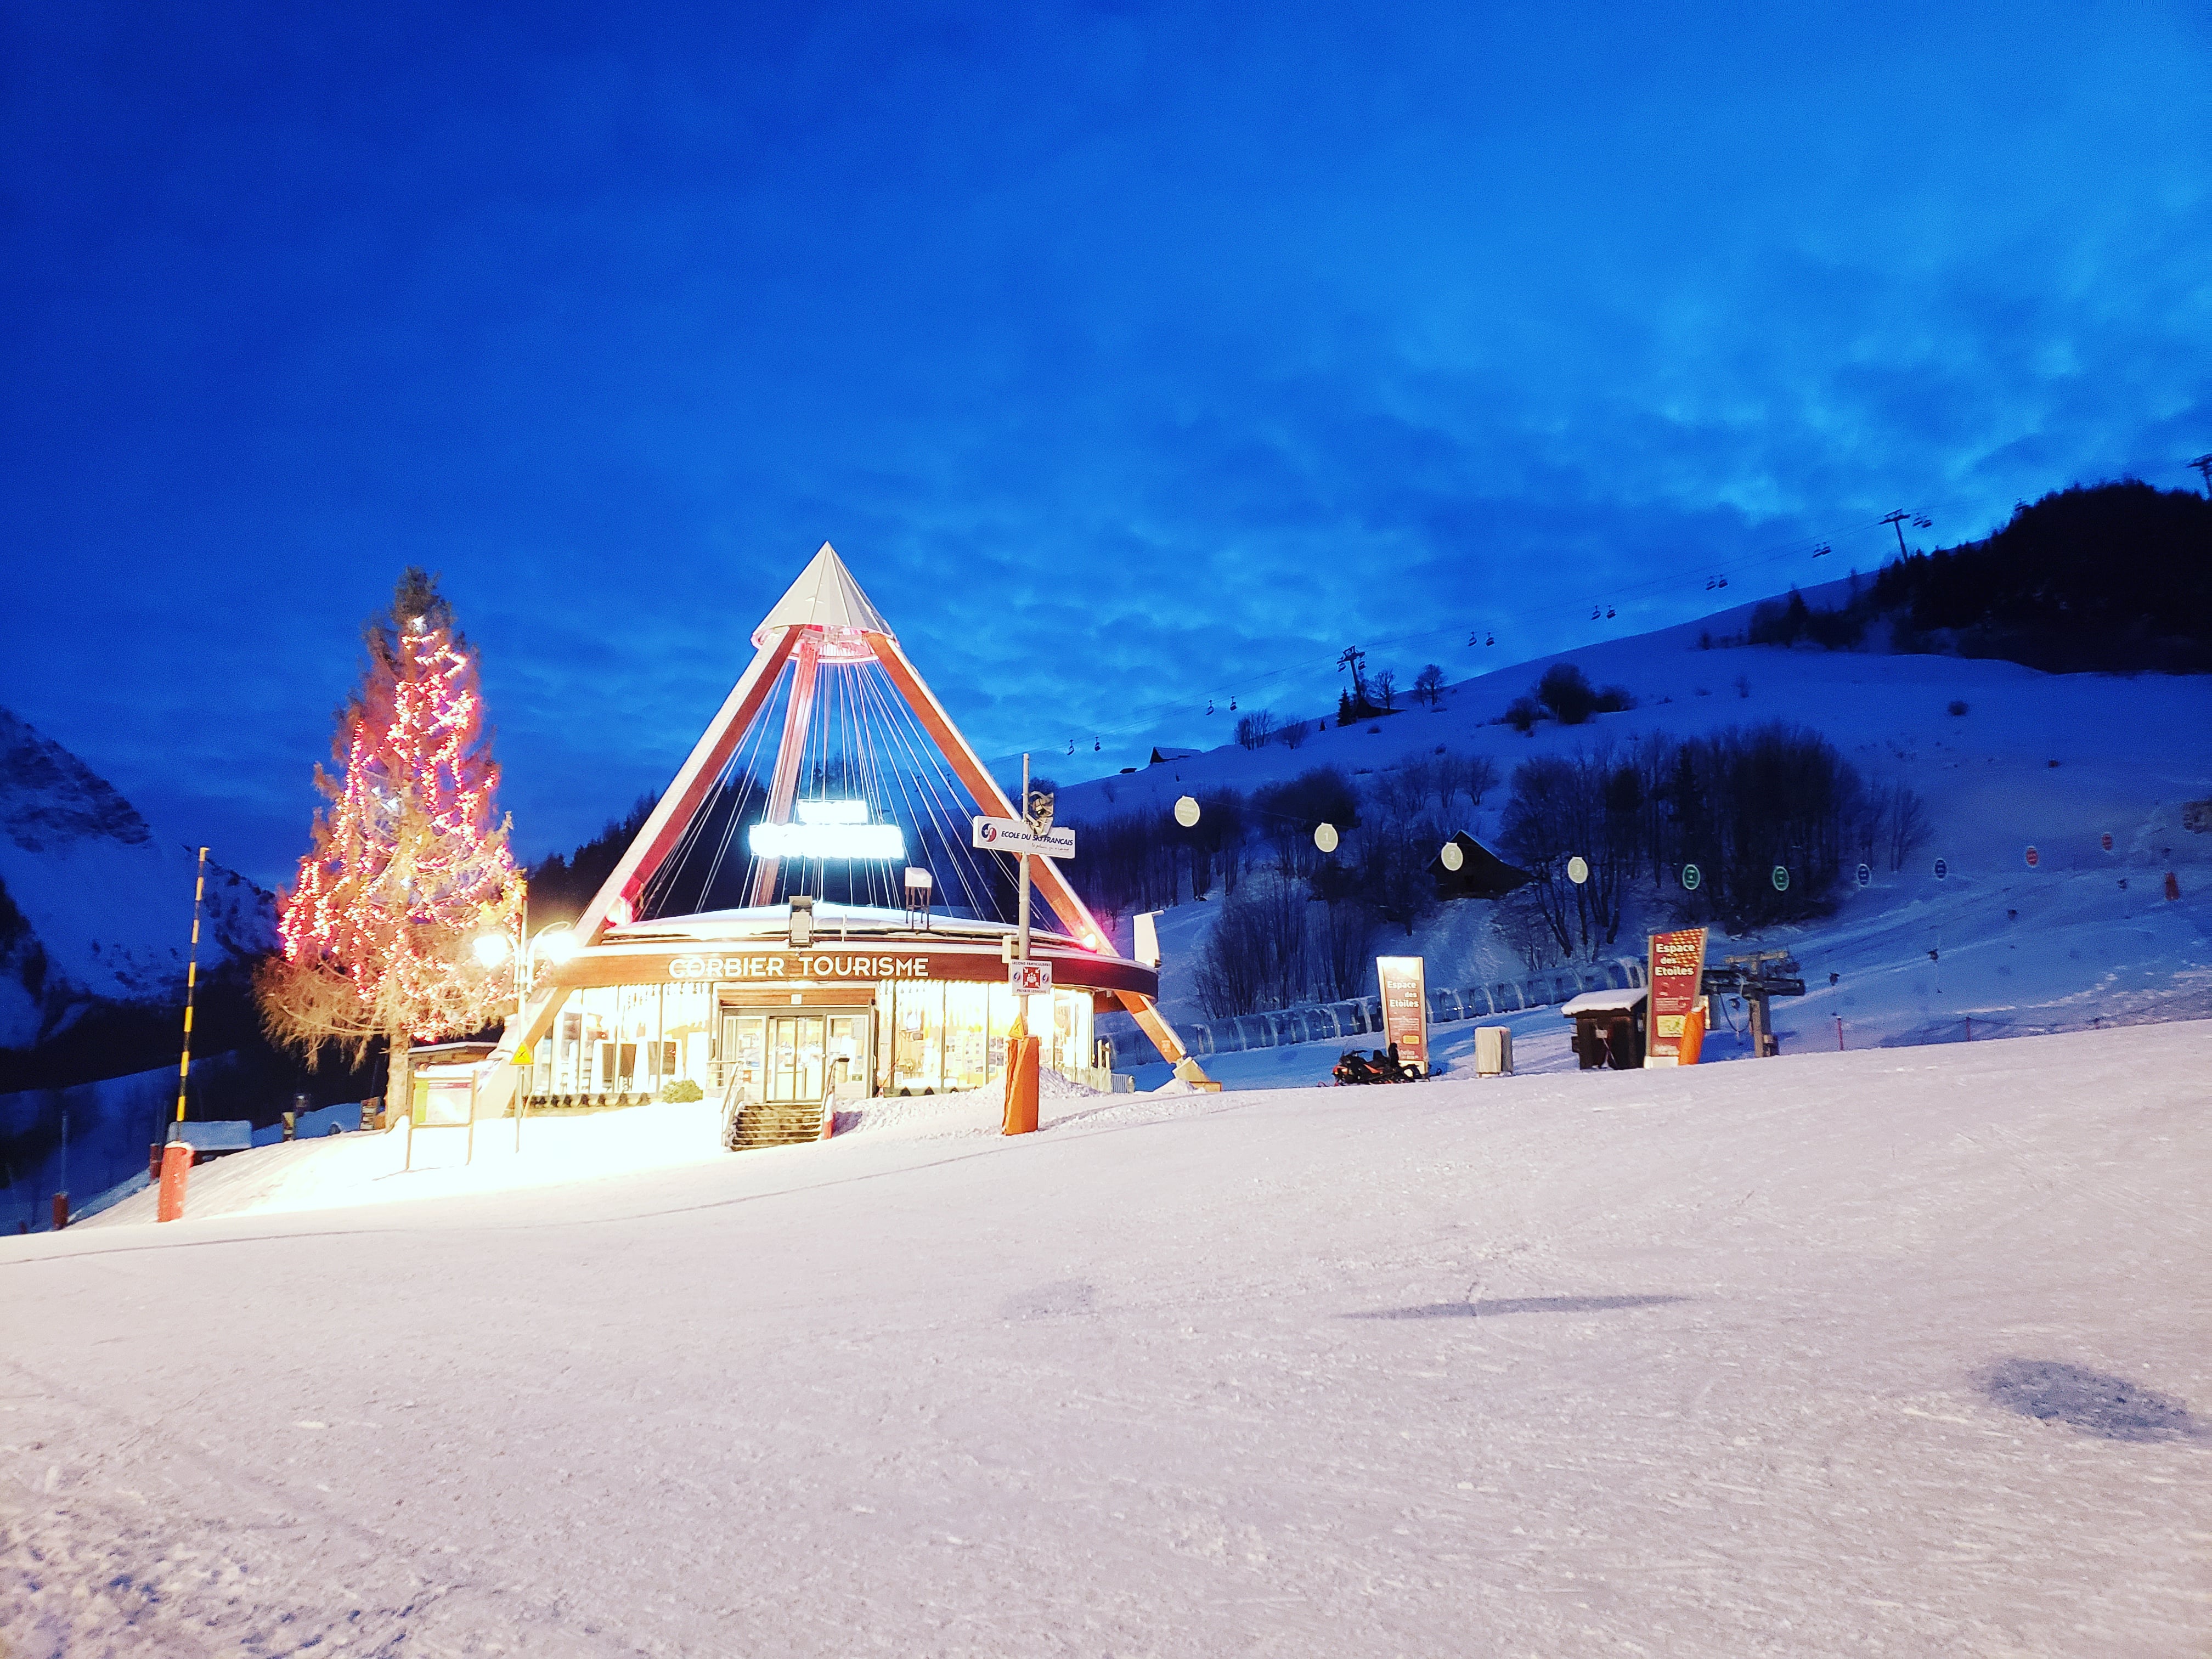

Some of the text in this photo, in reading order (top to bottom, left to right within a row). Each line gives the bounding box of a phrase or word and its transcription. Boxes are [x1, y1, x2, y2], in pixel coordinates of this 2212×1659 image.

[1001, 831, 1020, 839] ECOLE
[1656, 943, 1695, 955] Espace
[1660, 956, 1677, 964] des
[668, 956, 929, 978] CORBIER TOURISME
[1655, 966, 1694, 976] Etoiles
[1387, 980, 1417, 990] Espace
[1389, 999, 1419, 1007] Etoiles
